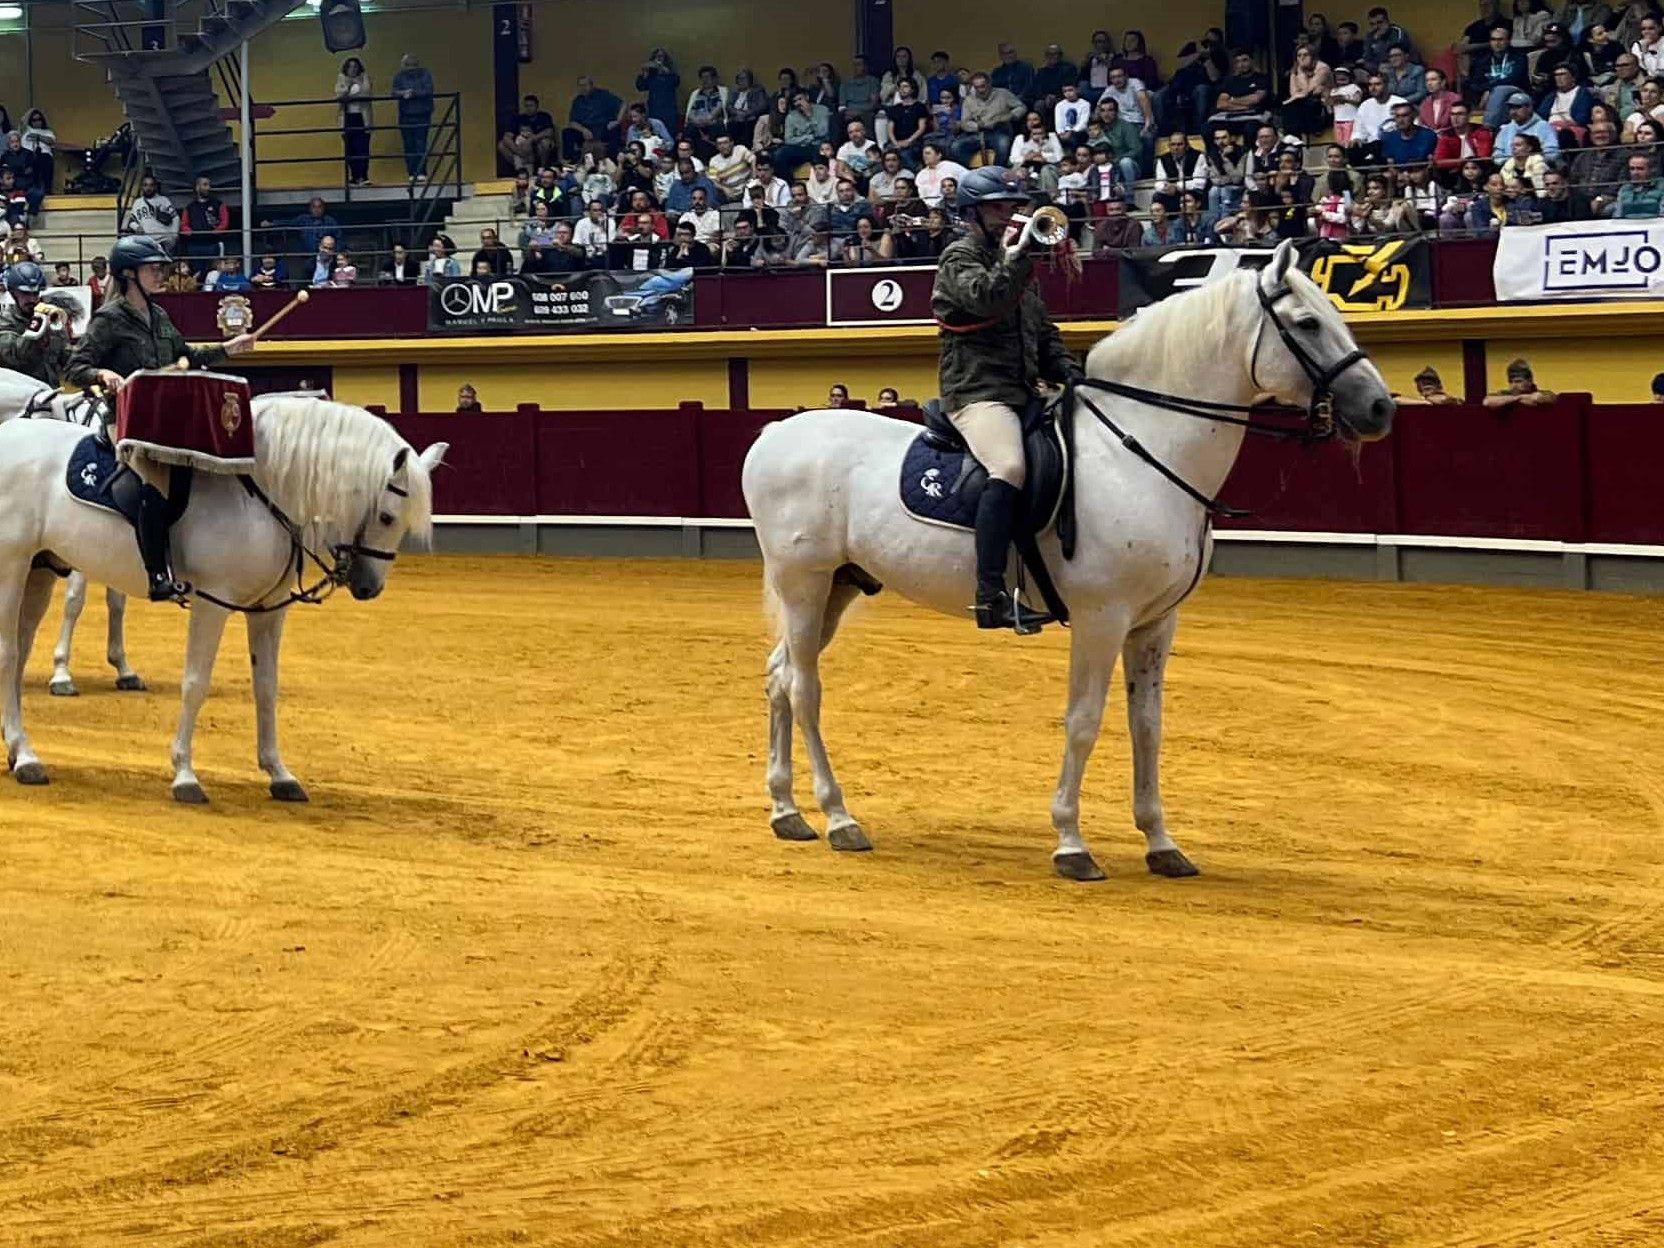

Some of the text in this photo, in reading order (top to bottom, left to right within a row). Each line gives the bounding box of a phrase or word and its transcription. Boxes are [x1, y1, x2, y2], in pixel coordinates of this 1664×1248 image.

[501, 19, 511, 34] 2
[1560, 246, 1661, 275] EMJO
[880, 282, 895, 306] 2
